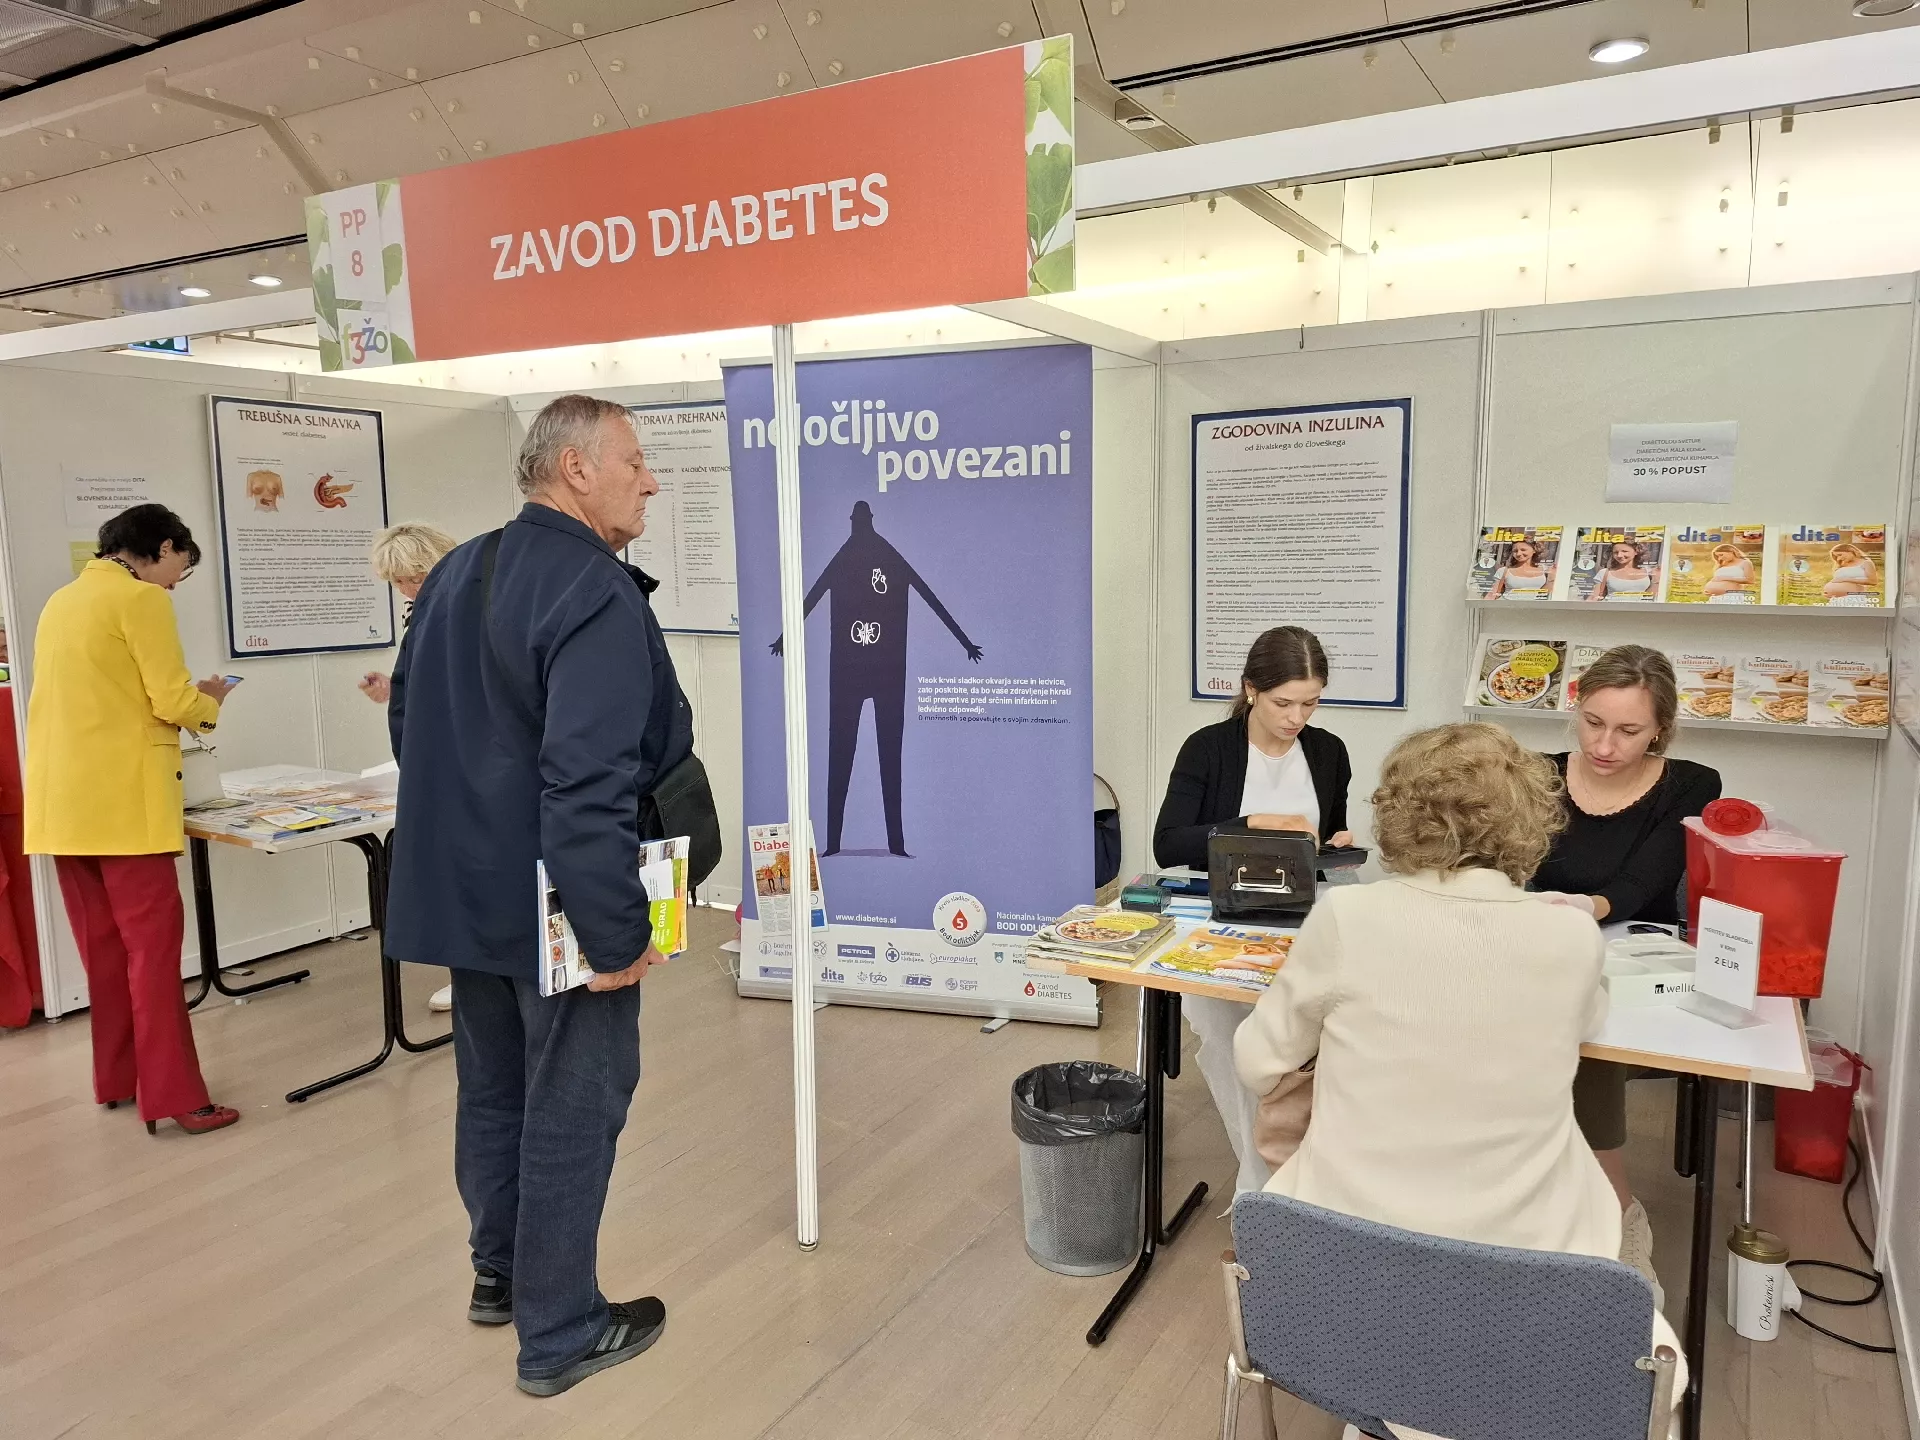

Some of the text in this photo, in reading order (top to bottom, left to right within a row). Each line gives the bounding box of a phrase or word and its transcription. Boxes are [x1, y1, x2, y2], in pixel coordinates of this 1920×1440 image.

[340, 209, 366, 238] PP
[491, 173, 888, 280] ZAVOD DIABETES
[352, 250, 363, 276] 8
[238, 409, 361, 430] TREBUŠNA SLINAVKA
[677, 411, 726, 424] PREHRANA
[1212, 416, 1385, 440] ZGODOVINA INZULINA
[1245, 444, 1253, 452] od
[1256, 442, 1291, 451] živalskega
[1306, 439, 1346, 448] človeškega
[878, 430, 1071, 493] povezani
[1634, 468, 1646, 476] 30
[1662, 466, 1707, 475] POPUST
[1485, 527, 1525, 542] dita
[1582, 528, 1625, 543] dita
[1678, 527, 1722, 542] dita
[1792, 526, 1840, 542] dita
[246, 635, 268, 647] dita
[1823, 664, 1871, 672] kulinarika
[985, 678, 1011, 686] okvarja
[1039, 678, 1066, 686] ledvice,
[1208, 678, 1232, 690] dita
[992, 687, 1009, 695] vaše
[1010, 688, 1048, 697] zdravljenje
[971, 697, 986, 705] pred
[988, 697, 1013, 705] srčnim
[1015, 697, 1049, 705] infarktom
[658, 902, 666, 927] GRAD
[836, 913, 897, 924] www.diabetes.si
[997, 912, 1035, 920] Nacionalna
[956, 918, 964, 928] 5
[997, 922, 1018, 931] BODI
[940, 928, 952, 941] Bodi
[1209, 926, 1264, 941] dita
[1714, 956, 1739, 971] 2 EUR
[821, 966, 844, 981] dita
[1038, 991, 1072, 999] DIABETES
